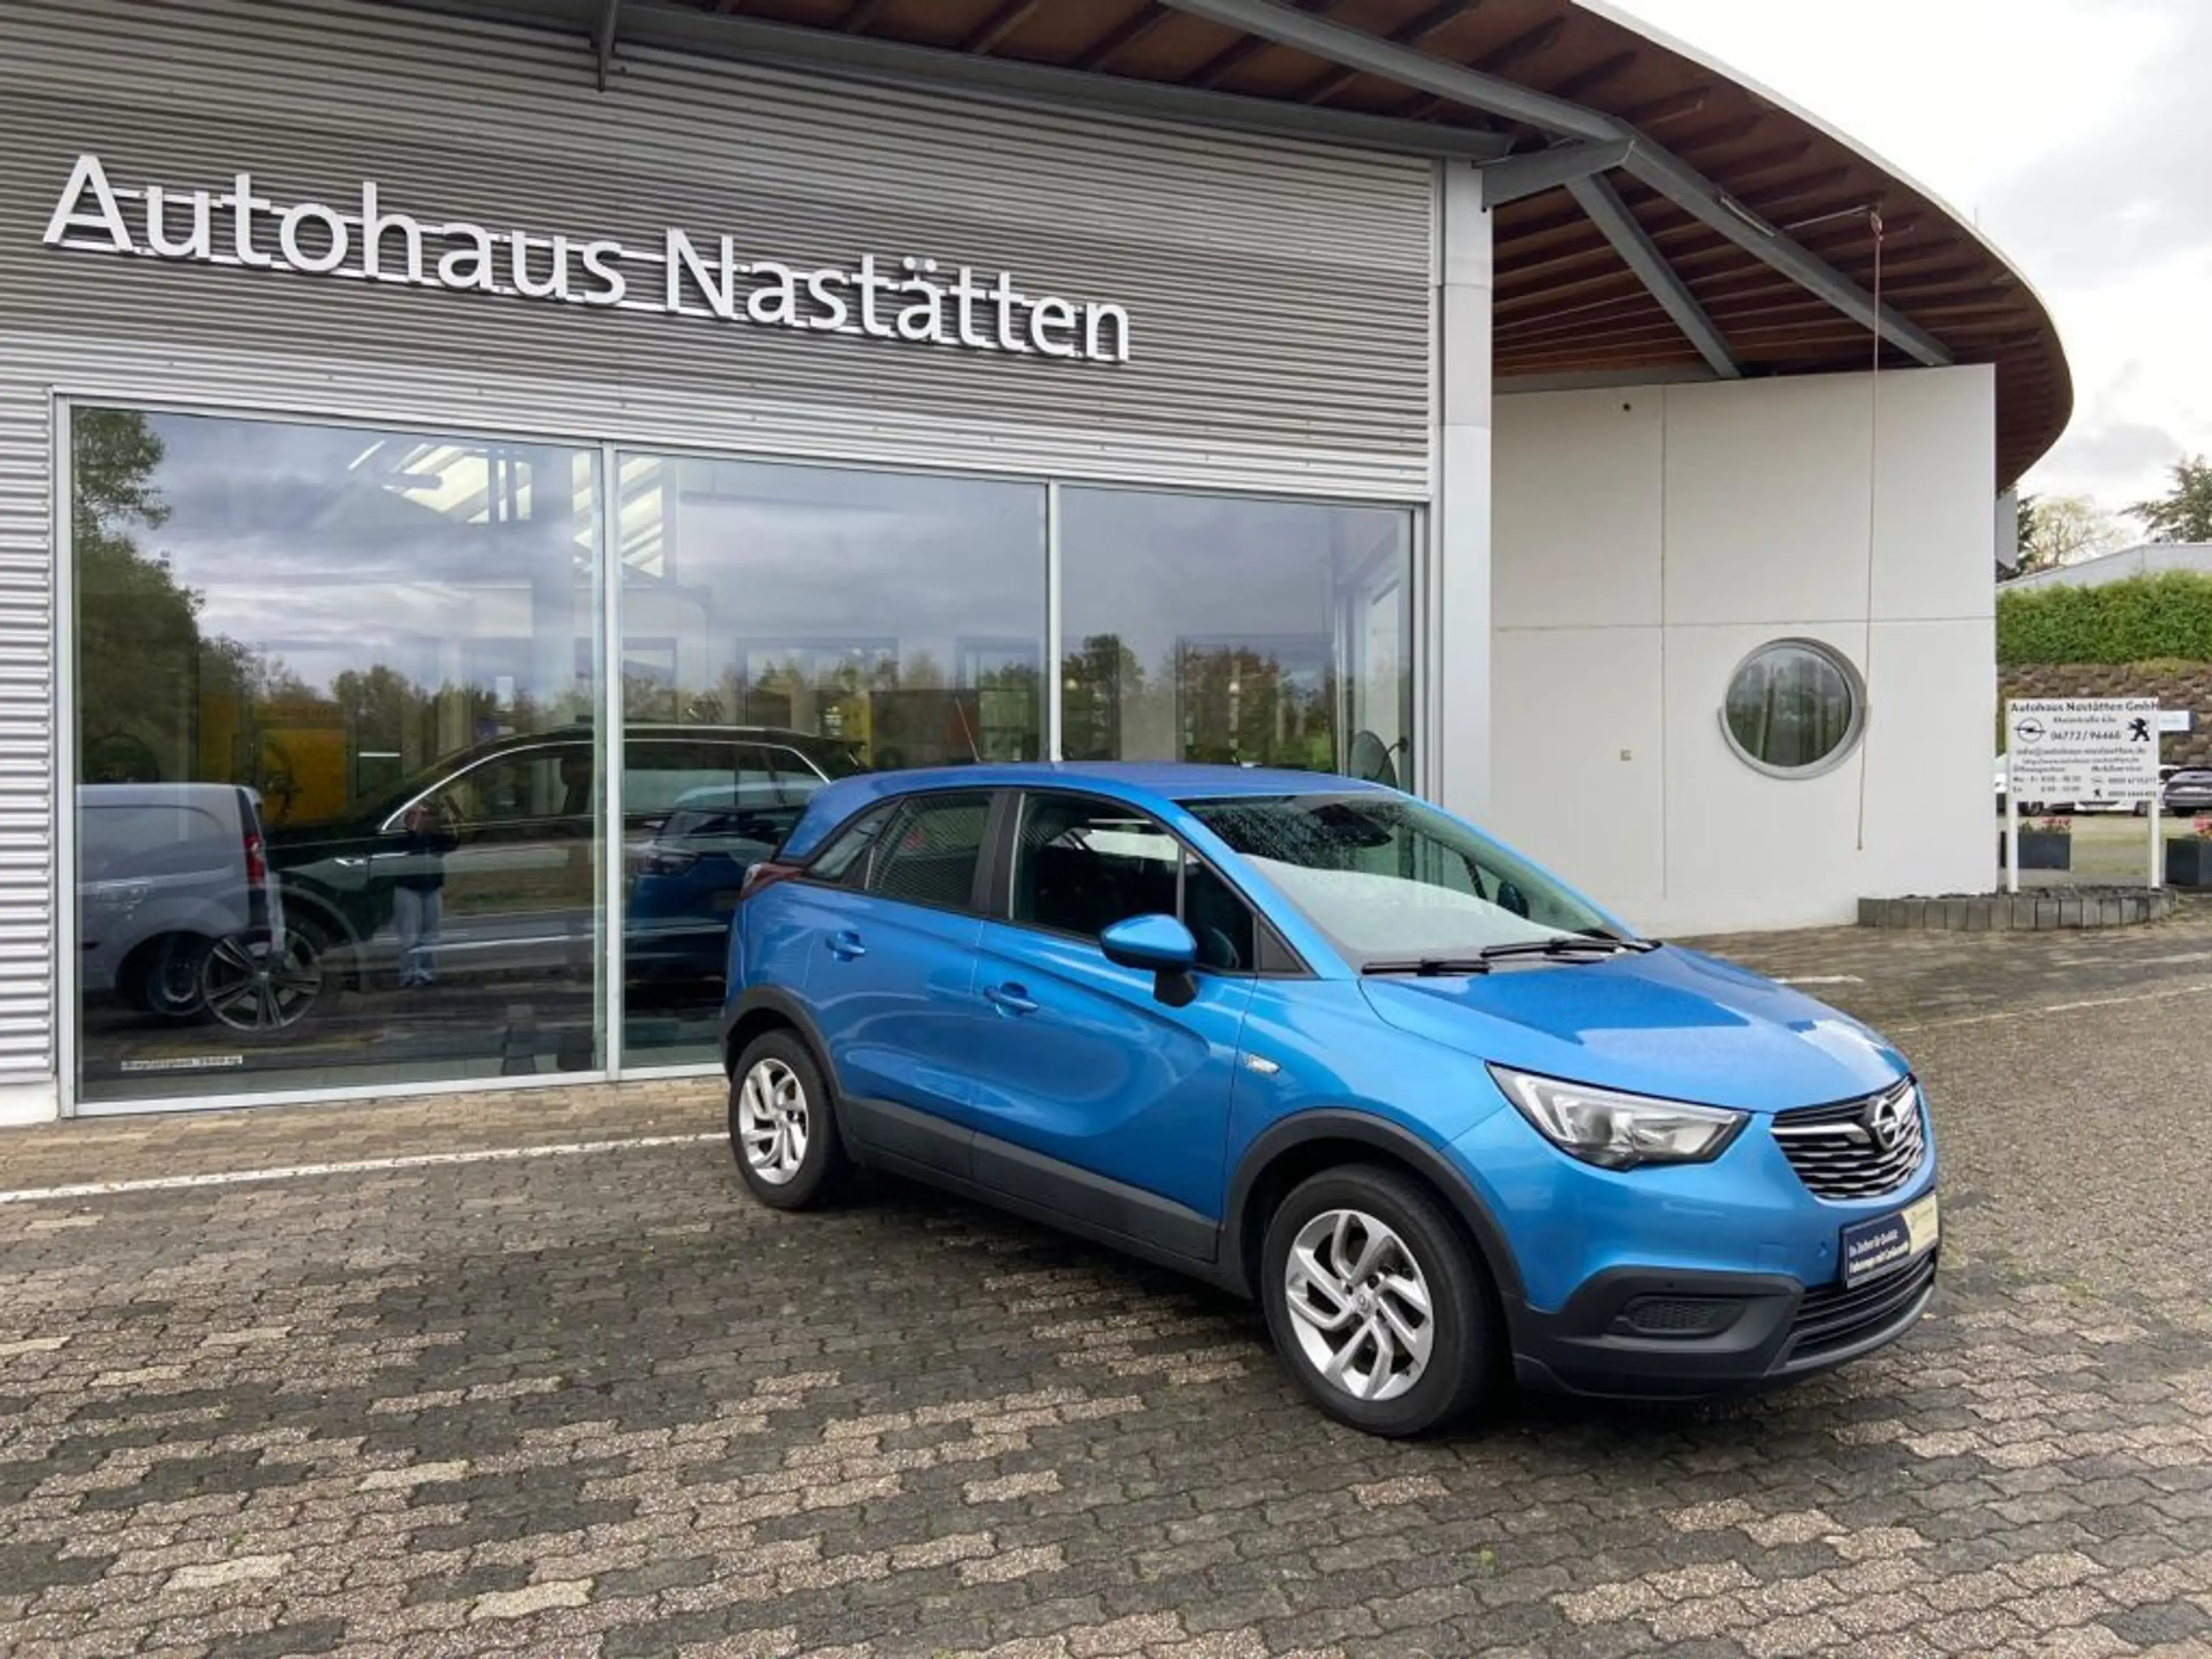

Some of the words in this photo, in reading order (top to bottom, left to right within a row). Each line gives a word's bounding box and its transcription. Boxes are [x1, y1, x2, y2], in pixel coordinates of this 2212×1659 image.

[43, 155, 627, 306] Autohaus
[665, 227, 1129, 363] Nastätten
[2011, 702, 2064, 711] Autohaus
[2066, 700, 2124, 711] Nastätten
[2126, 700, 2158, 711] GmbH
